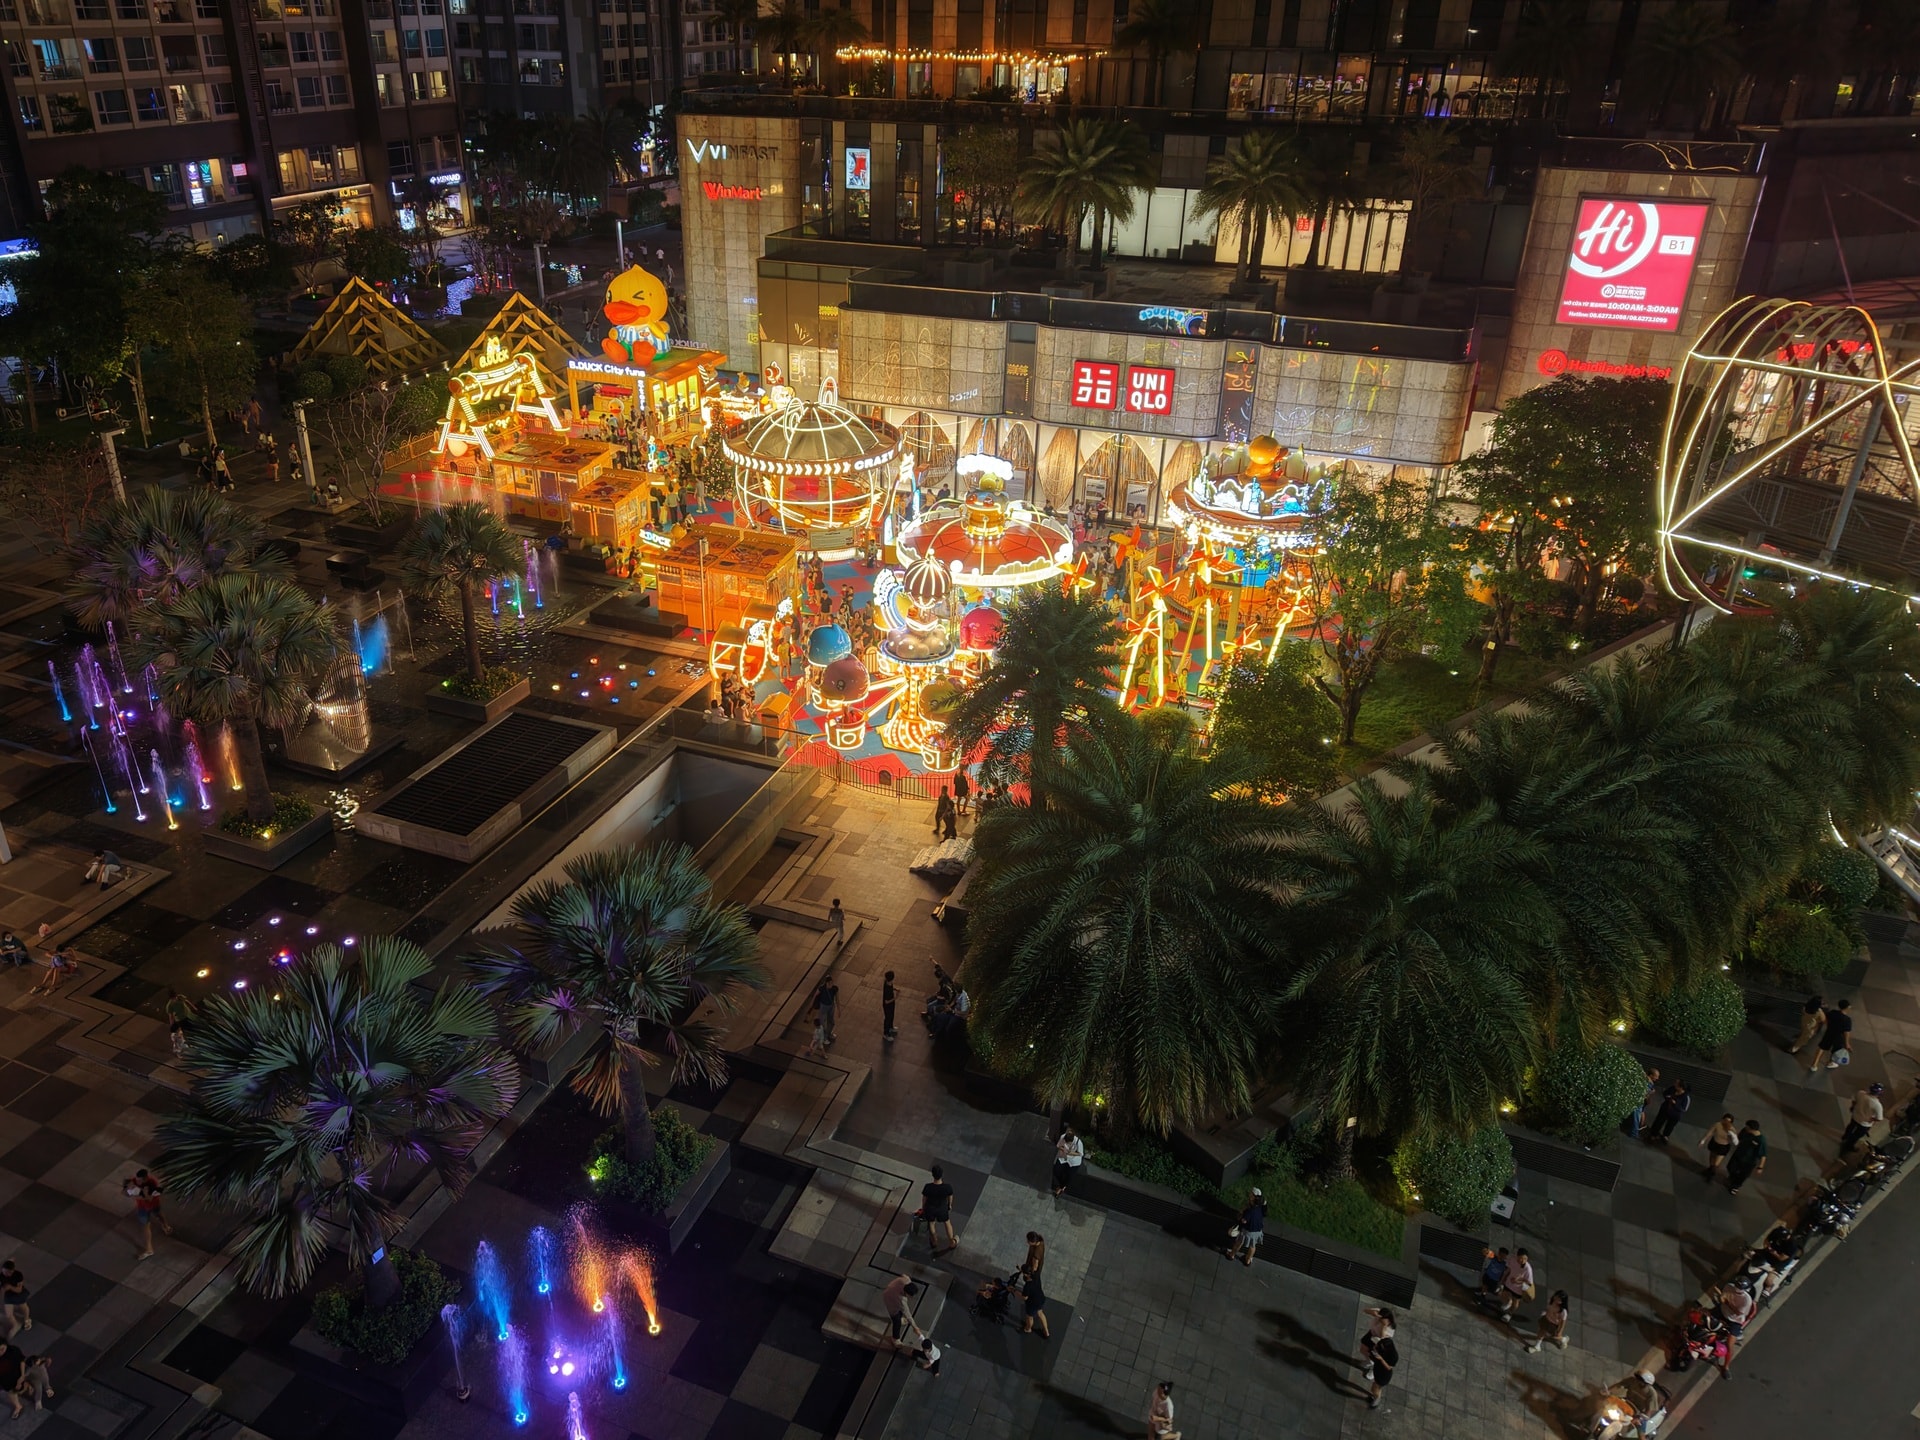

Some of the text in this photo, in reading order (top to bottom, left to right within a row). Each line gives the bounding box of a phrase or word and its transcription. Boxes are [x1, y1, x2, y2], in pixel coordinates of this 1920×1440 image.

[702, 181, 761, 201] WinMart
[1579, 203, 1633, 256] Hi
[1668, 239, 1686, 251] B1
[479, 349, 509, 368] B.DUCK
[568, 360, 603, 372] B.DUCK
[604, 364, 624, 376] City
[853, 449, 894, 471] CRAZY
